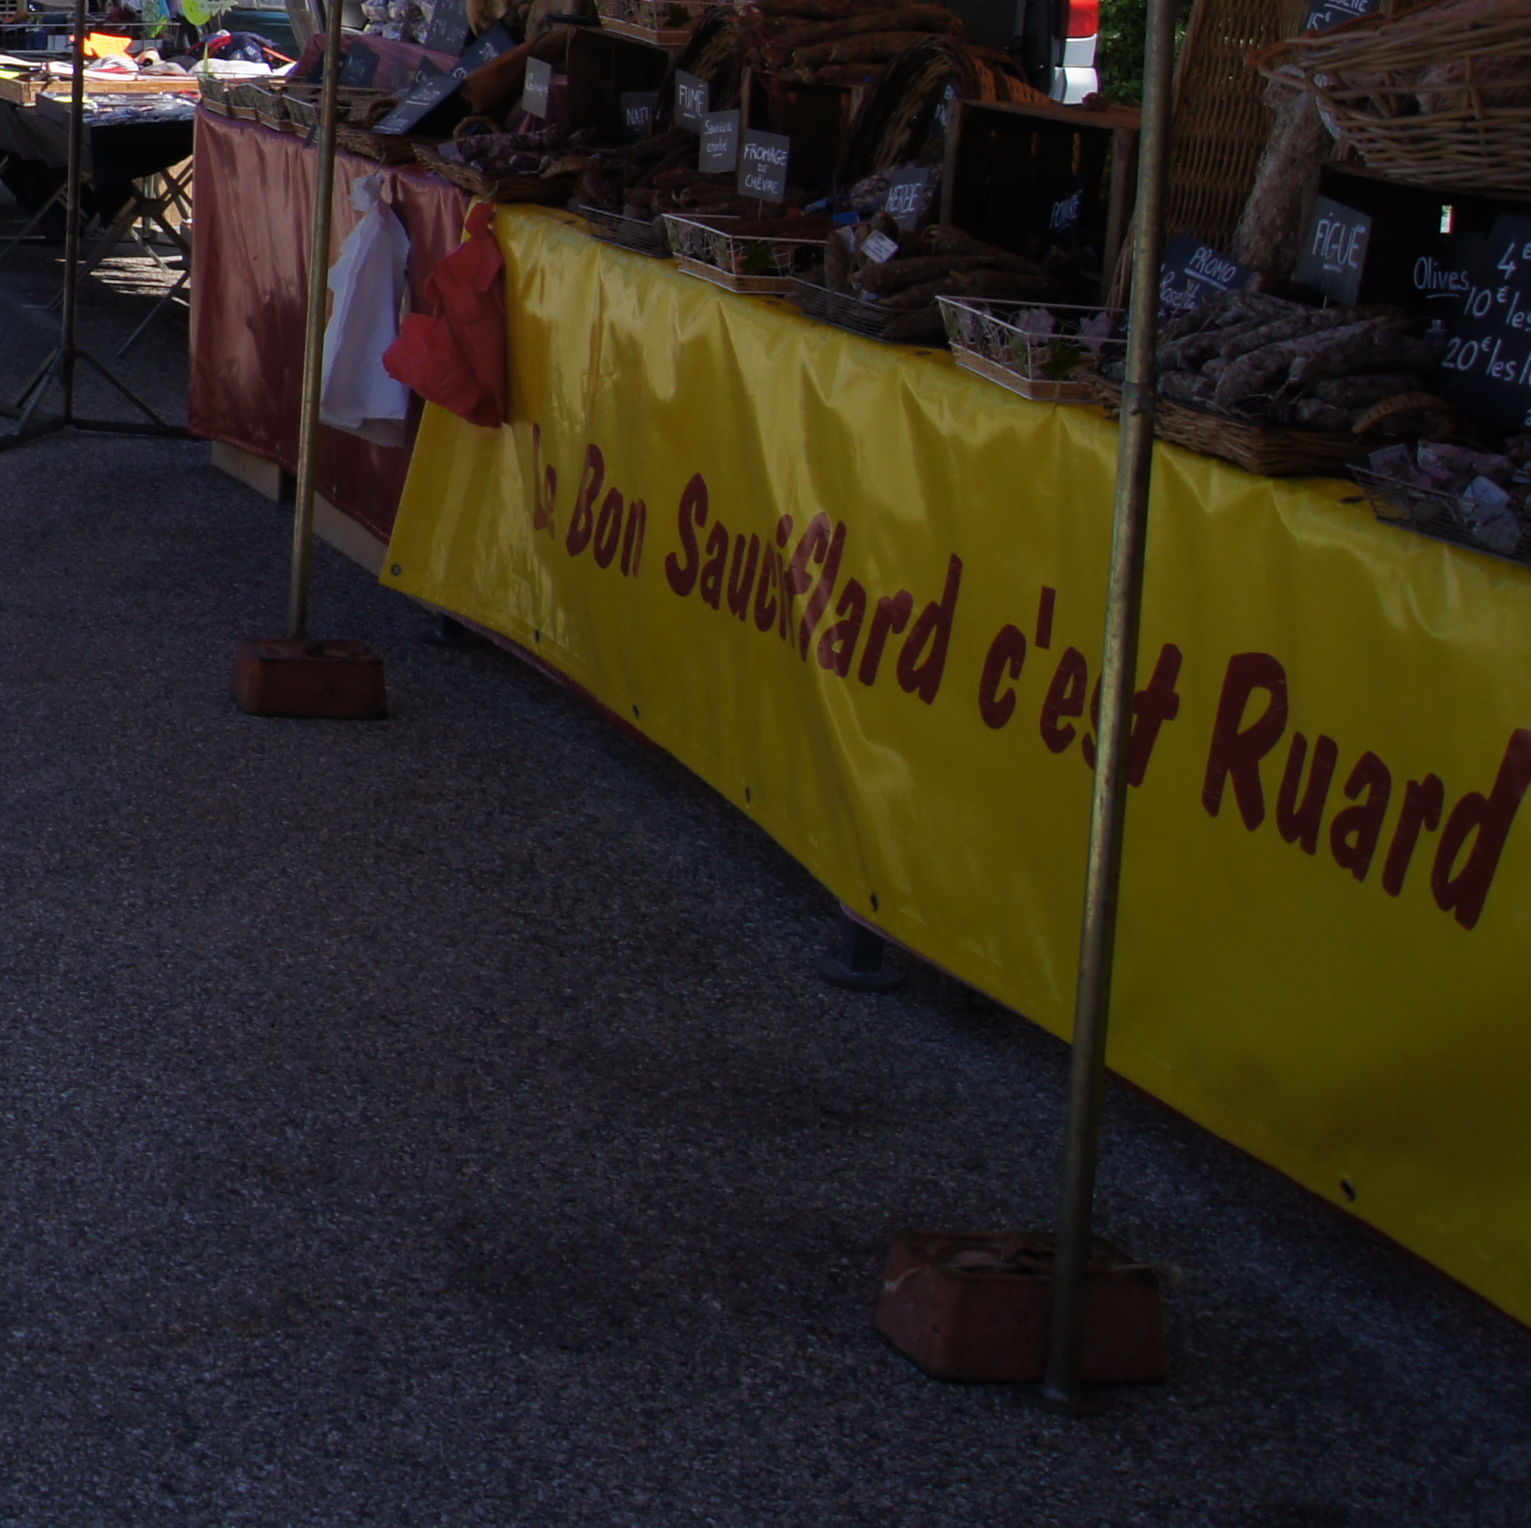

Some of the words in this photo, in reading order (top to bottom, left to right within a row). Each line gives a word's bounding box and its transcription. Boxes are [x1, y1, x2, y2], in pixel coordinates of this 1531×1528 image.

[742, 142, 789, 167] FROMAGE
[1314, 215, 1367, 269] FIGUE
[1189, 246, 1237, 284] PROMO
[1413, 256, 1470, 292] Olives
[567, 442, 646, 578] Bon
[665, 471, 964, 706] Sauciflard
[1201, 650, 1531, 932] Ruard
